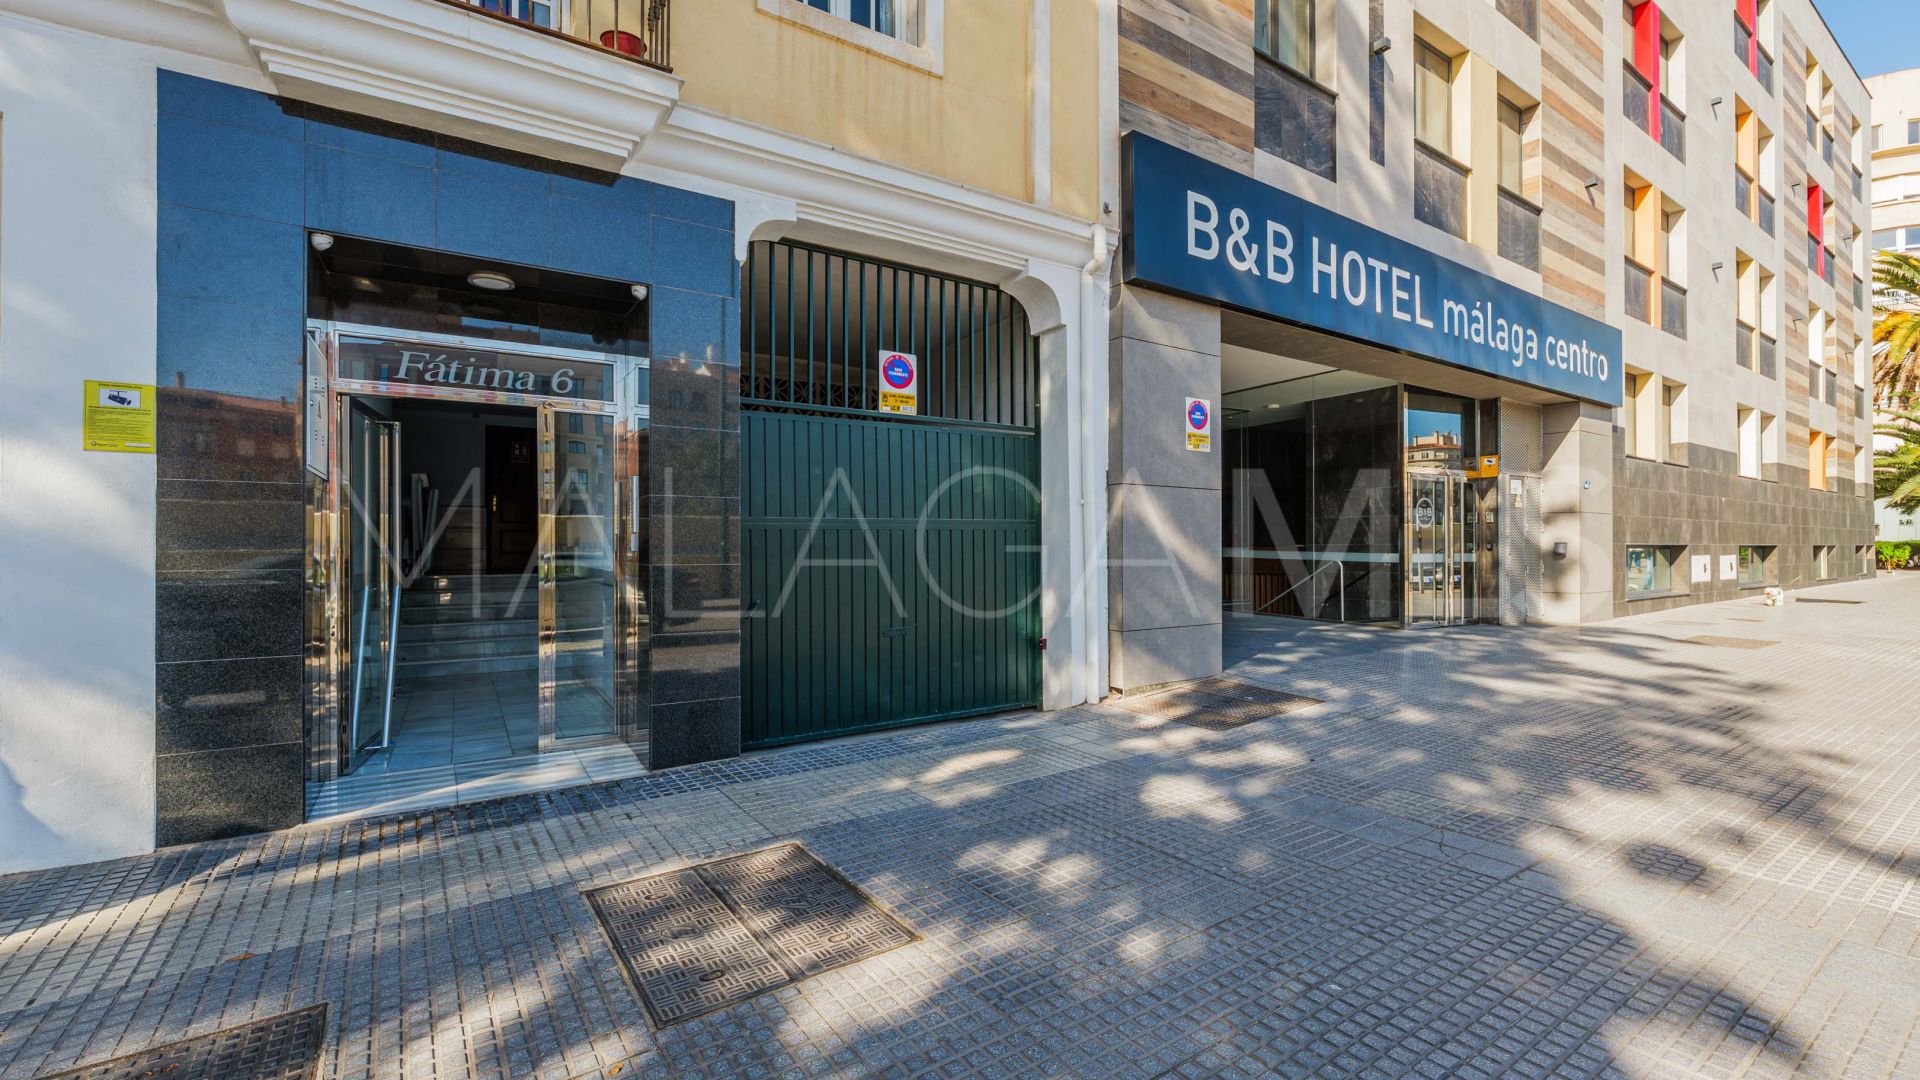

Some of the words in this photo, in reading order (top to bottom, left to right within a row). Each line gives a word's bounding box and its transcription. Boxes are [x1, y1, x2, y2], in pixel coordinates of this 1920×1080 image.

[1186, 189, 1294, 284] B&B
[1312, 235, 1434, 330] HOTEL
[1443, 295, 1538, 367] málaga
[1545, 335, 1608, 382] centro
[392, 350, 536, 391] Fátima
[551, 368, 575, 394] 6
